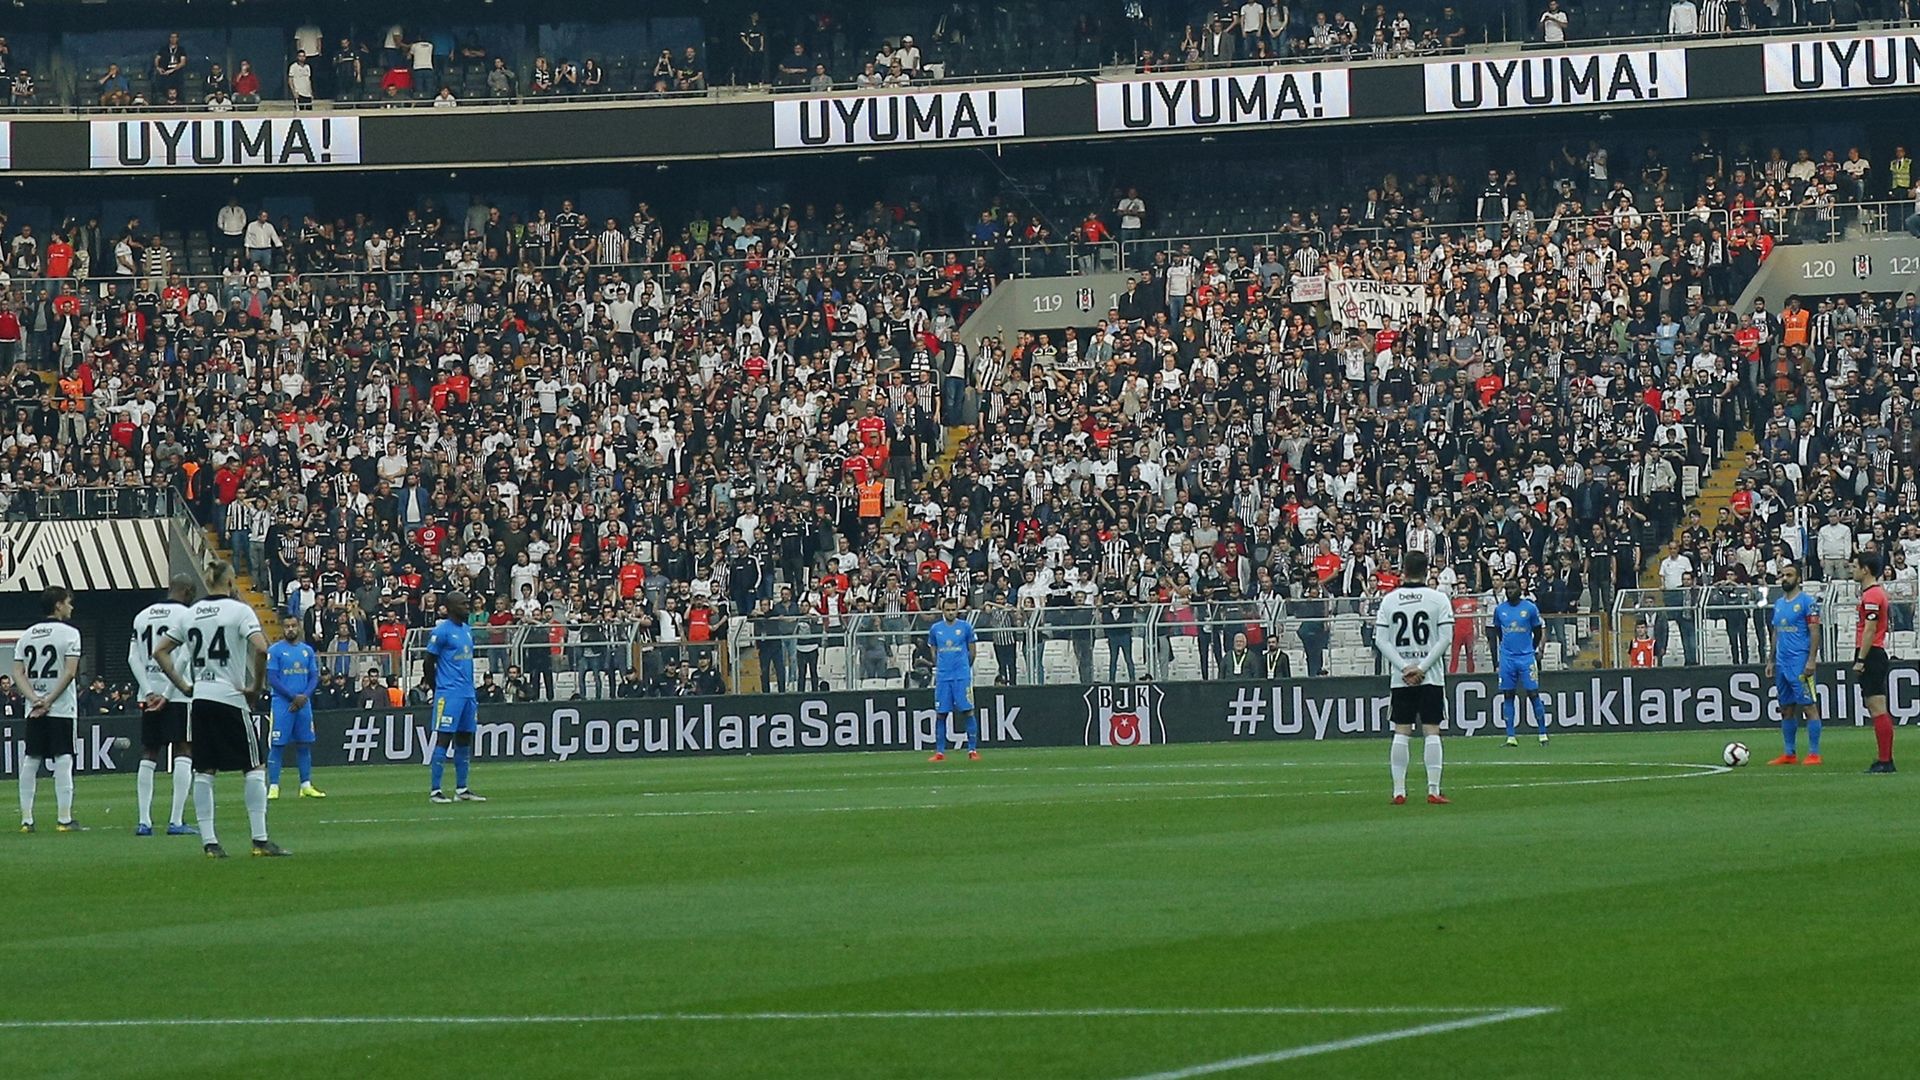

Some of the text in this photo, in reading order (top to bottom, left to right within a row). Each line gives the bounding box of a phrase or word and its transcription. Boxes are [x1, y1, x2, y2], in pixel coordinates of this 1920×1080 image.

[1122, 72, 1323, 128] UYUMA!
[1451, 52, 1658, 109] UYUMA!
[800, 91, 998, 145] UYUMA!
[118, 118, 332, 166] UYUMA!
[1802, 260, 1836, 278] 120
[1033, 294, 1062, 312] 119
[187, 626, 230, 668] 24
[1392, 611, 1430, 647] 26
[24, 644, 58, 679] 22
